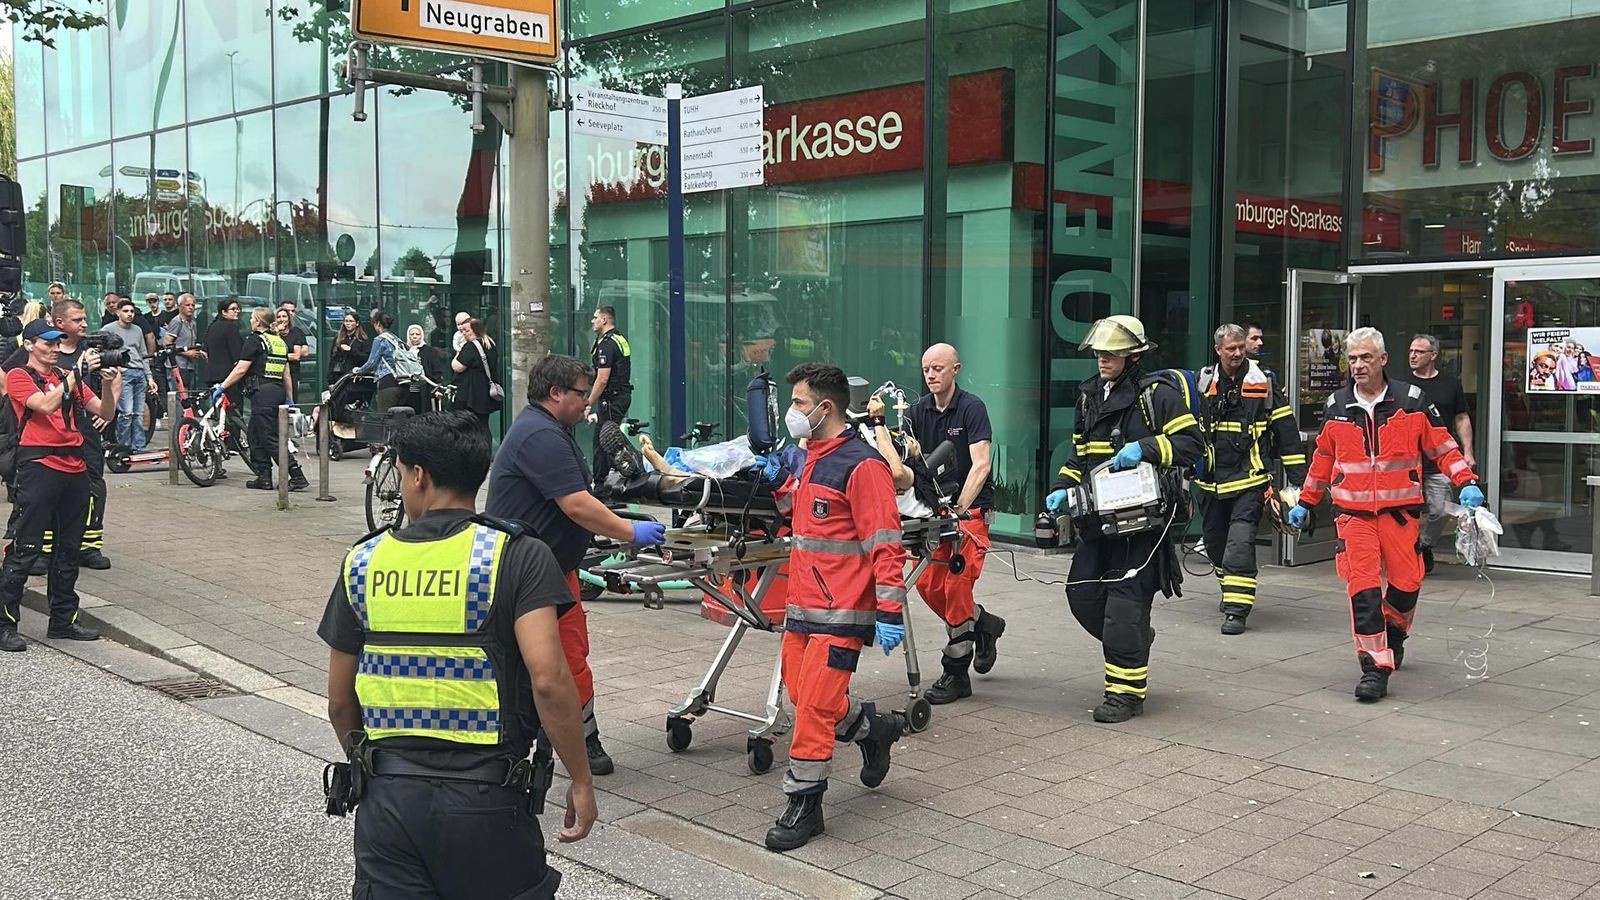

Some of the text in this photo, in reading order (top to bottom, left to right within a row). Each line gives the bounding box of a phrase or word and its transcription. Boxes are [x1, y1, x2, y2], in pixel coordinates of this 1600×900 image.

[427, 2, 544, 38] Neugraben
[587, 90, 650, 105] Veranstaltungszentrum
[587, 99, 617, 112] Rieckhof
[683, 105, 699, 115] TUHH
[588, 119, 624, 132] Seeveplatz
[683, 126, 722, 138] Rathausforum
[683, 150, 714, 161] Innenstadt
[684, 170, 713, 180] Sammlung
[684, 180, 718, 190] Falckenberg
[372, 569, 460, 597] POLIZEI
